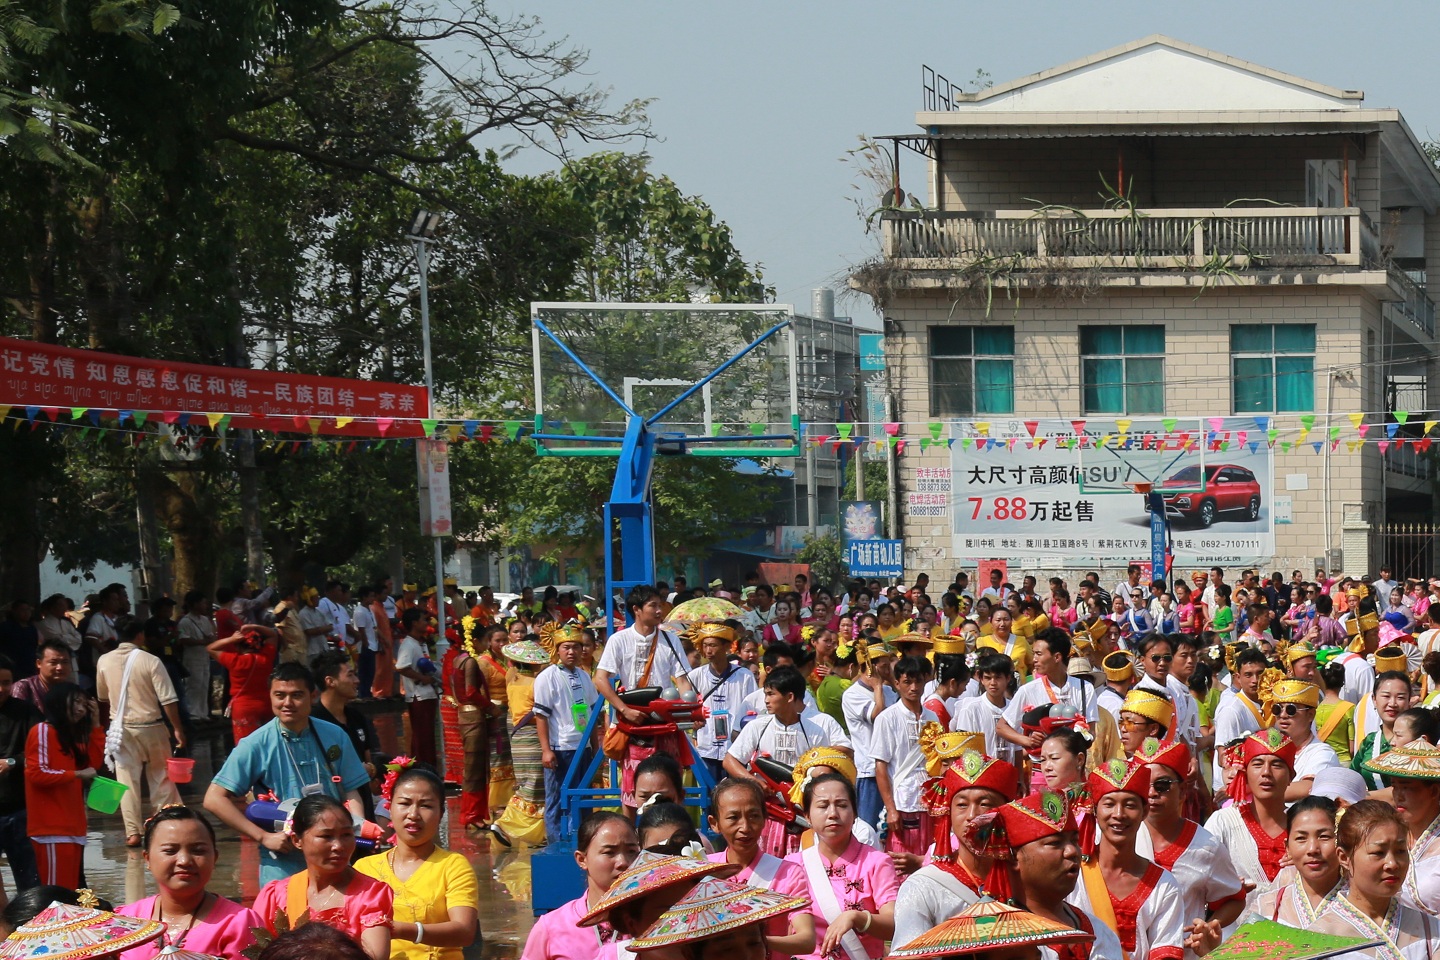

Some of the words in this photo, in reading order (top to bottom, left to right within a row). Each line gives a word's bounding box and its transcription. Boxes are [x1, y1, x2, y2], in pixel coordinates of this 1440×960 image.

[1, 349, 76, 380] 记党情
[967, 497, 1094, 522] 7.88万起售
